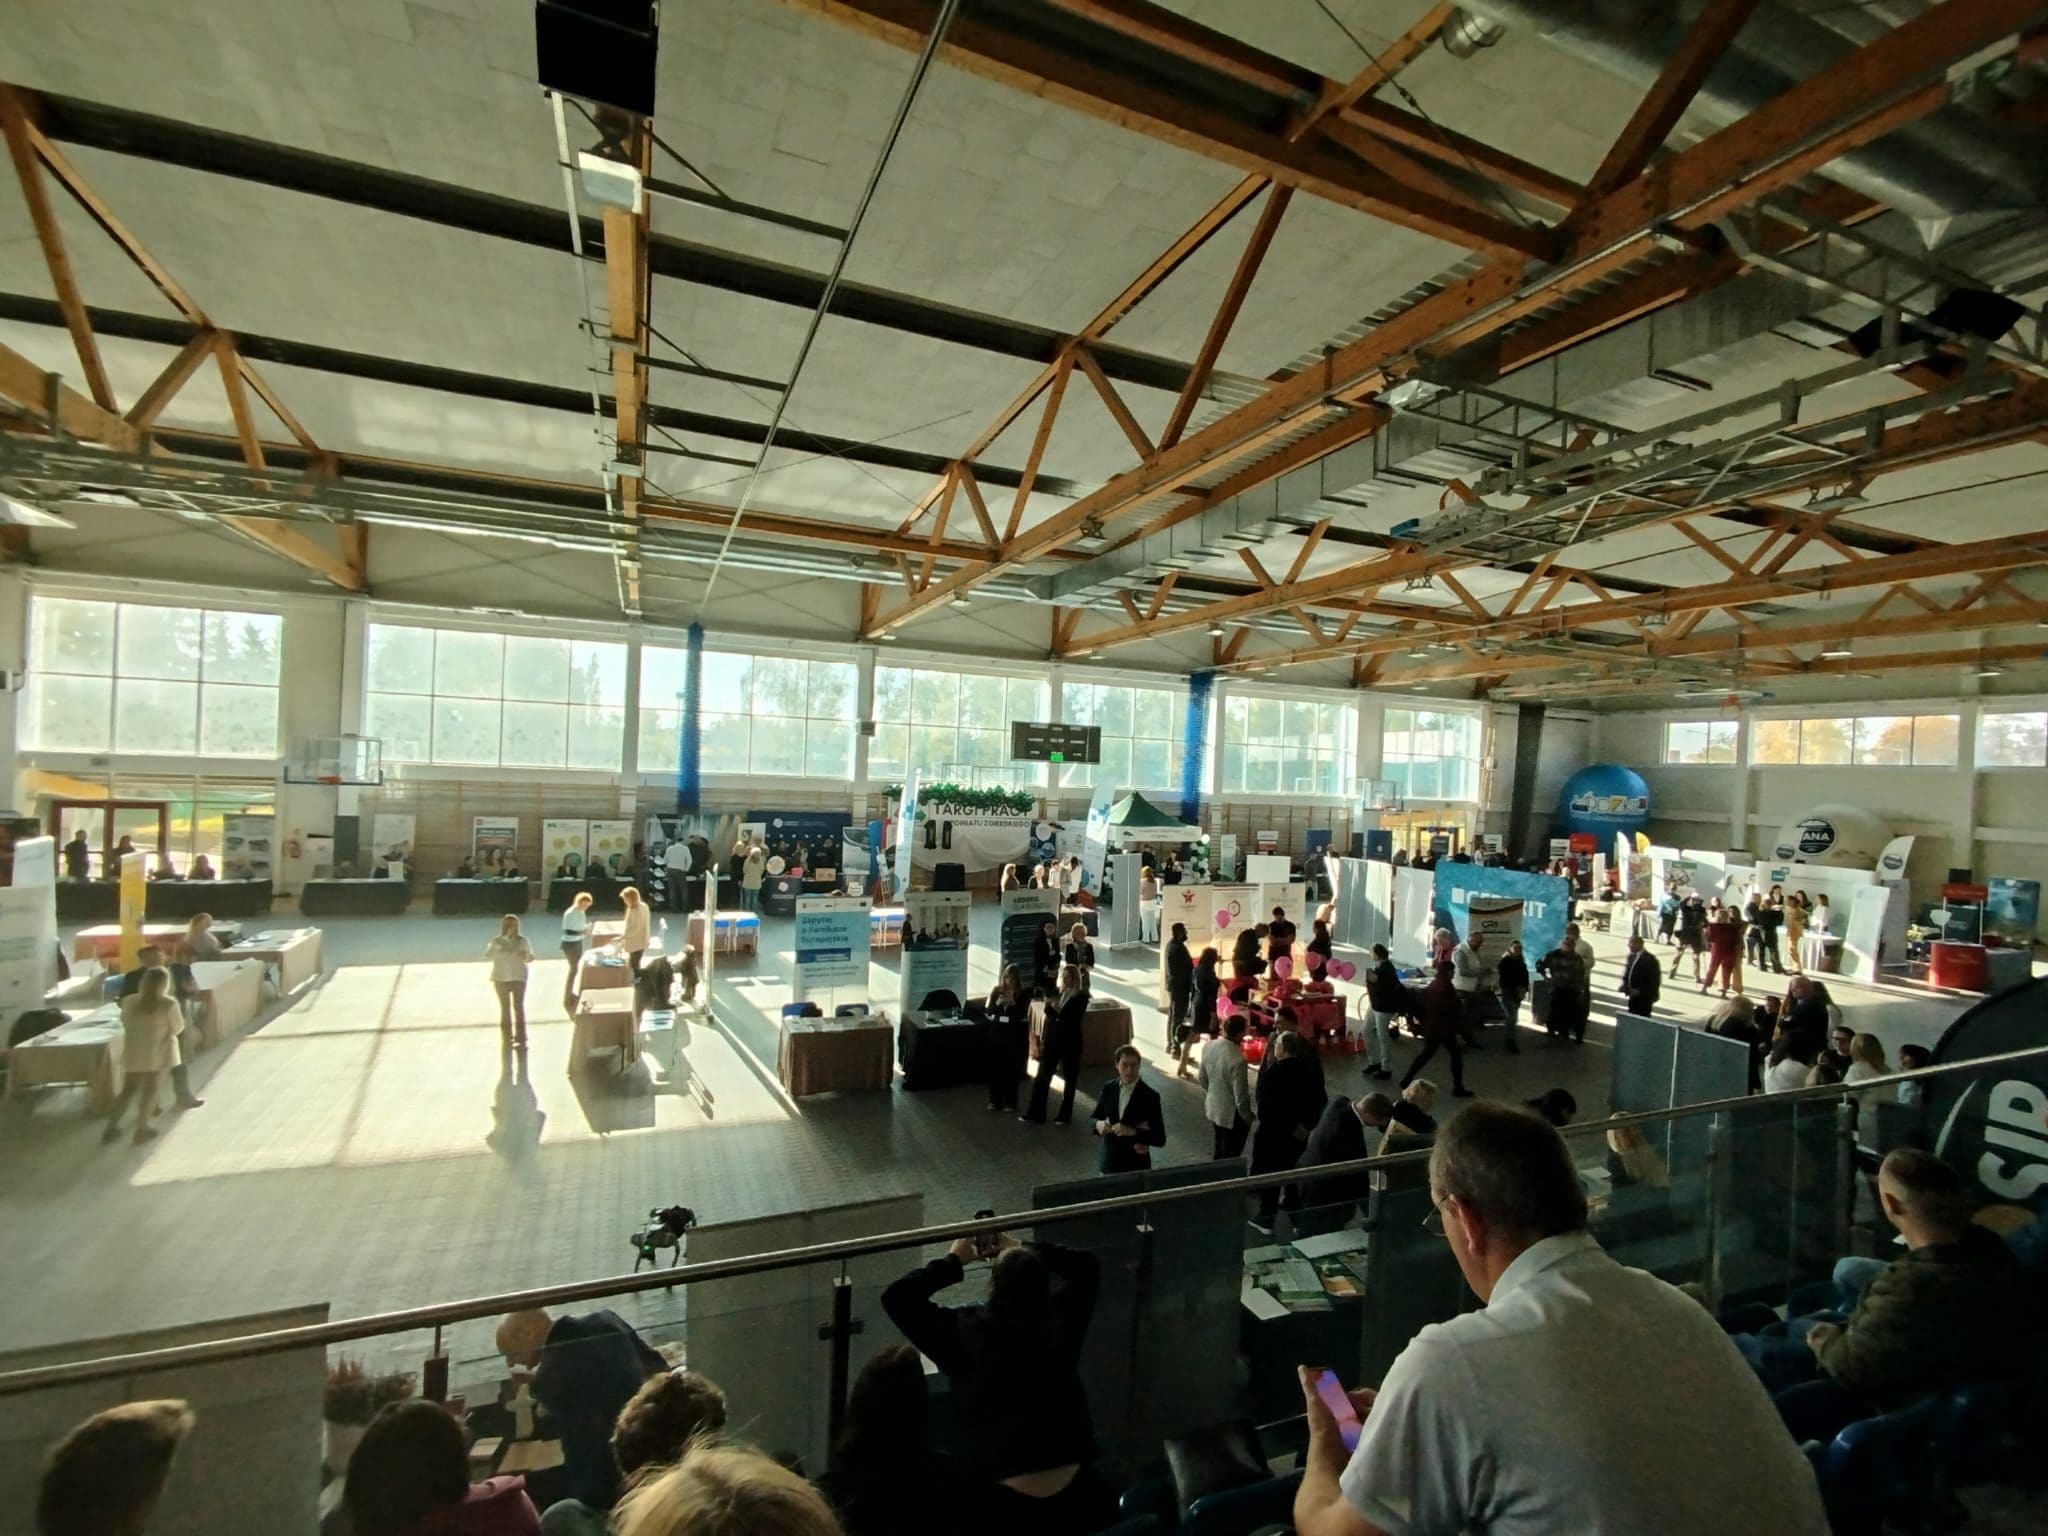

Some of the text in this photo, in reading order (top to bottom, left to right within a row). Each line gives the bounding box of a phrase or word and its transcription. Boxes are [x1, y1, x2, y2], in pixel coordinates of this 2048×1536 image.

[934, 802, 979, 817] TARGI
[1803, 832, 1830, 841] ANA
[802, 916, 833, 926] Zapytaj
[809, 926, 848, 934] Fundusze
[801, 935, 849, 945] Europejskie
